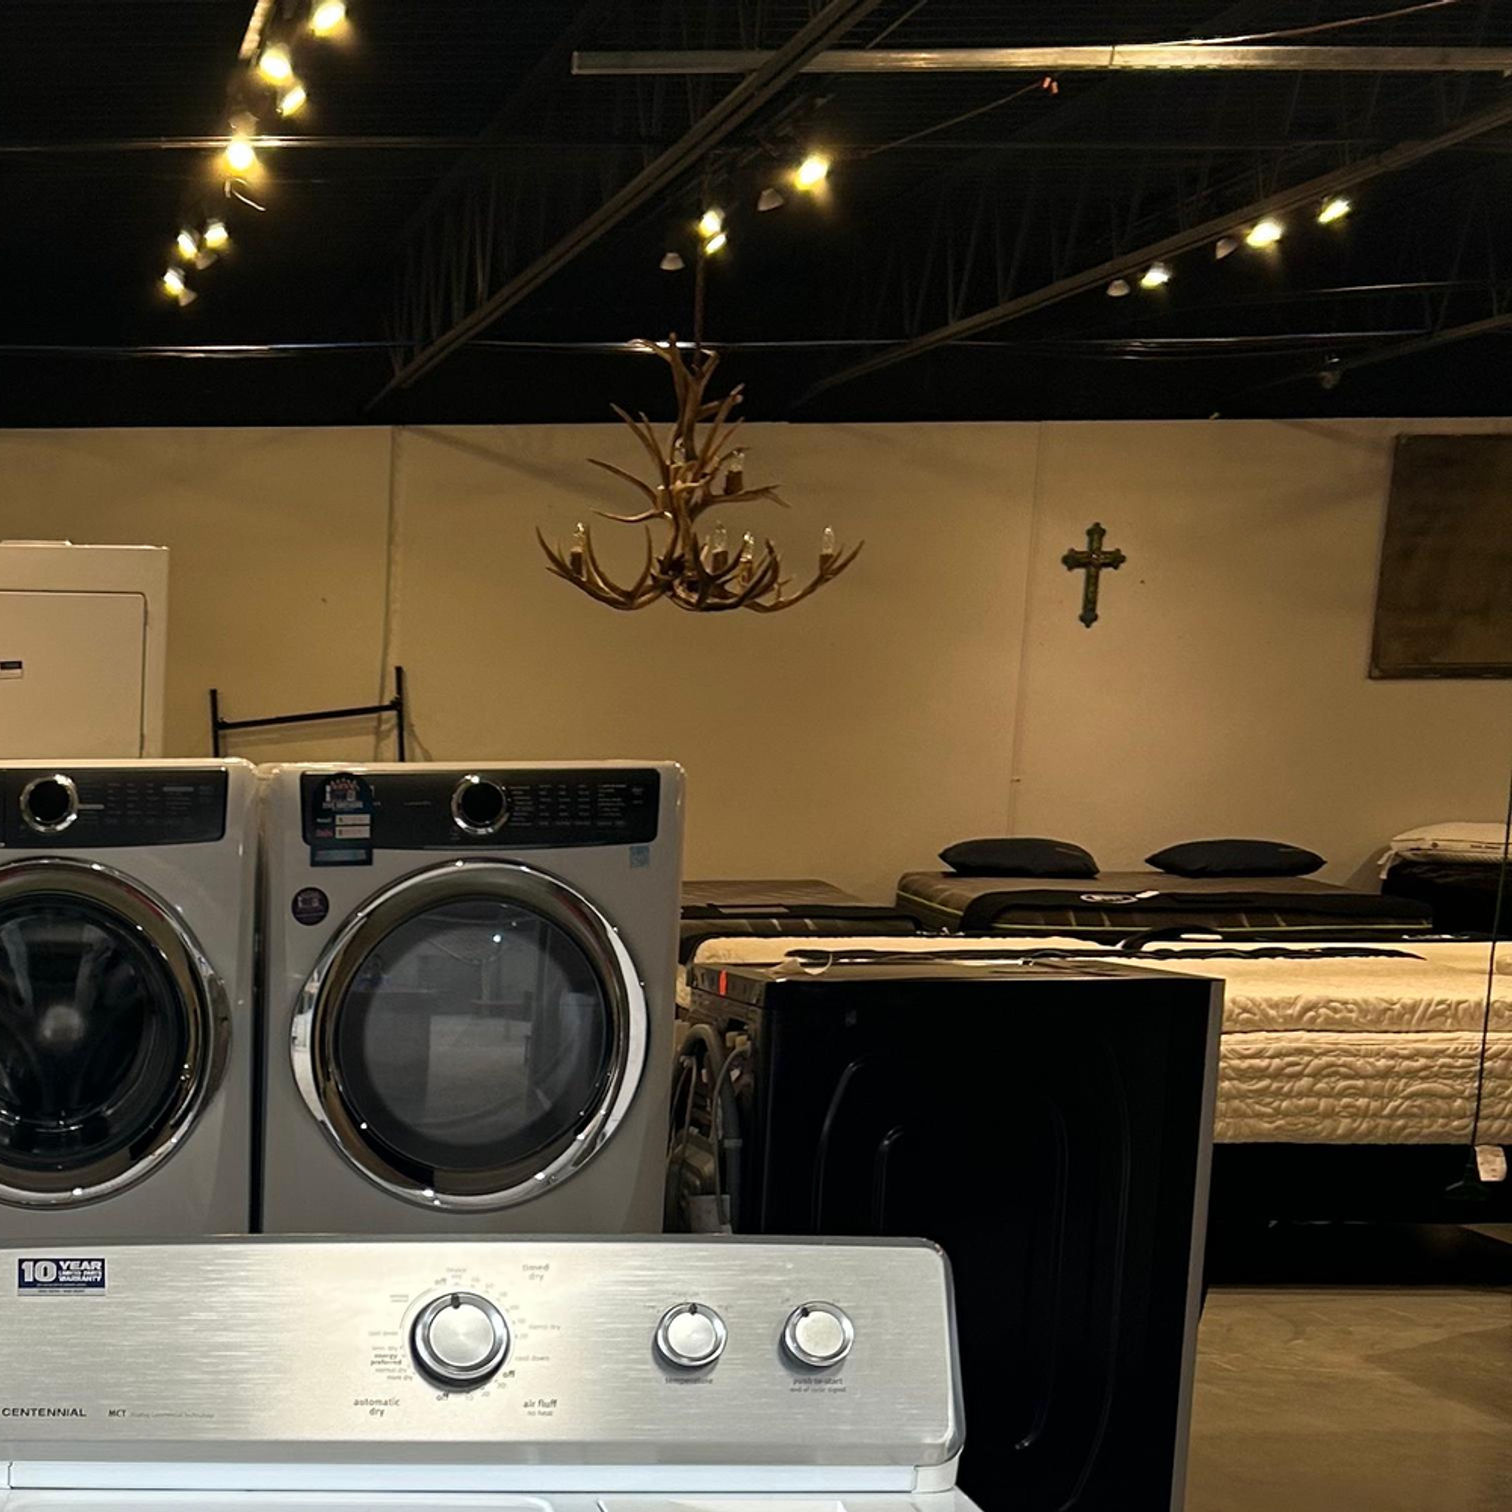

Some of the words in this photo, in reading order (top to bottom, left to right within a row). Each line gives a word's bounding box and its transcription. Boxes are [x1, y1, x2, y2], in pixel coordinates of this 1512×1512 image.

[21, 1261, 57, 1282] 10
[59, 1261, 102, 1270] YEAR
[353, 1399, 400, 1407] automatic
[523, 1399, 536, 1408] air
[537, 1399, 558, 1408] fluff
[1, 1407, 87, 1417] CENTENNIAL
[108, 1409, 127, 1417] MCT
[369, 1407, 384, 1417] dry
